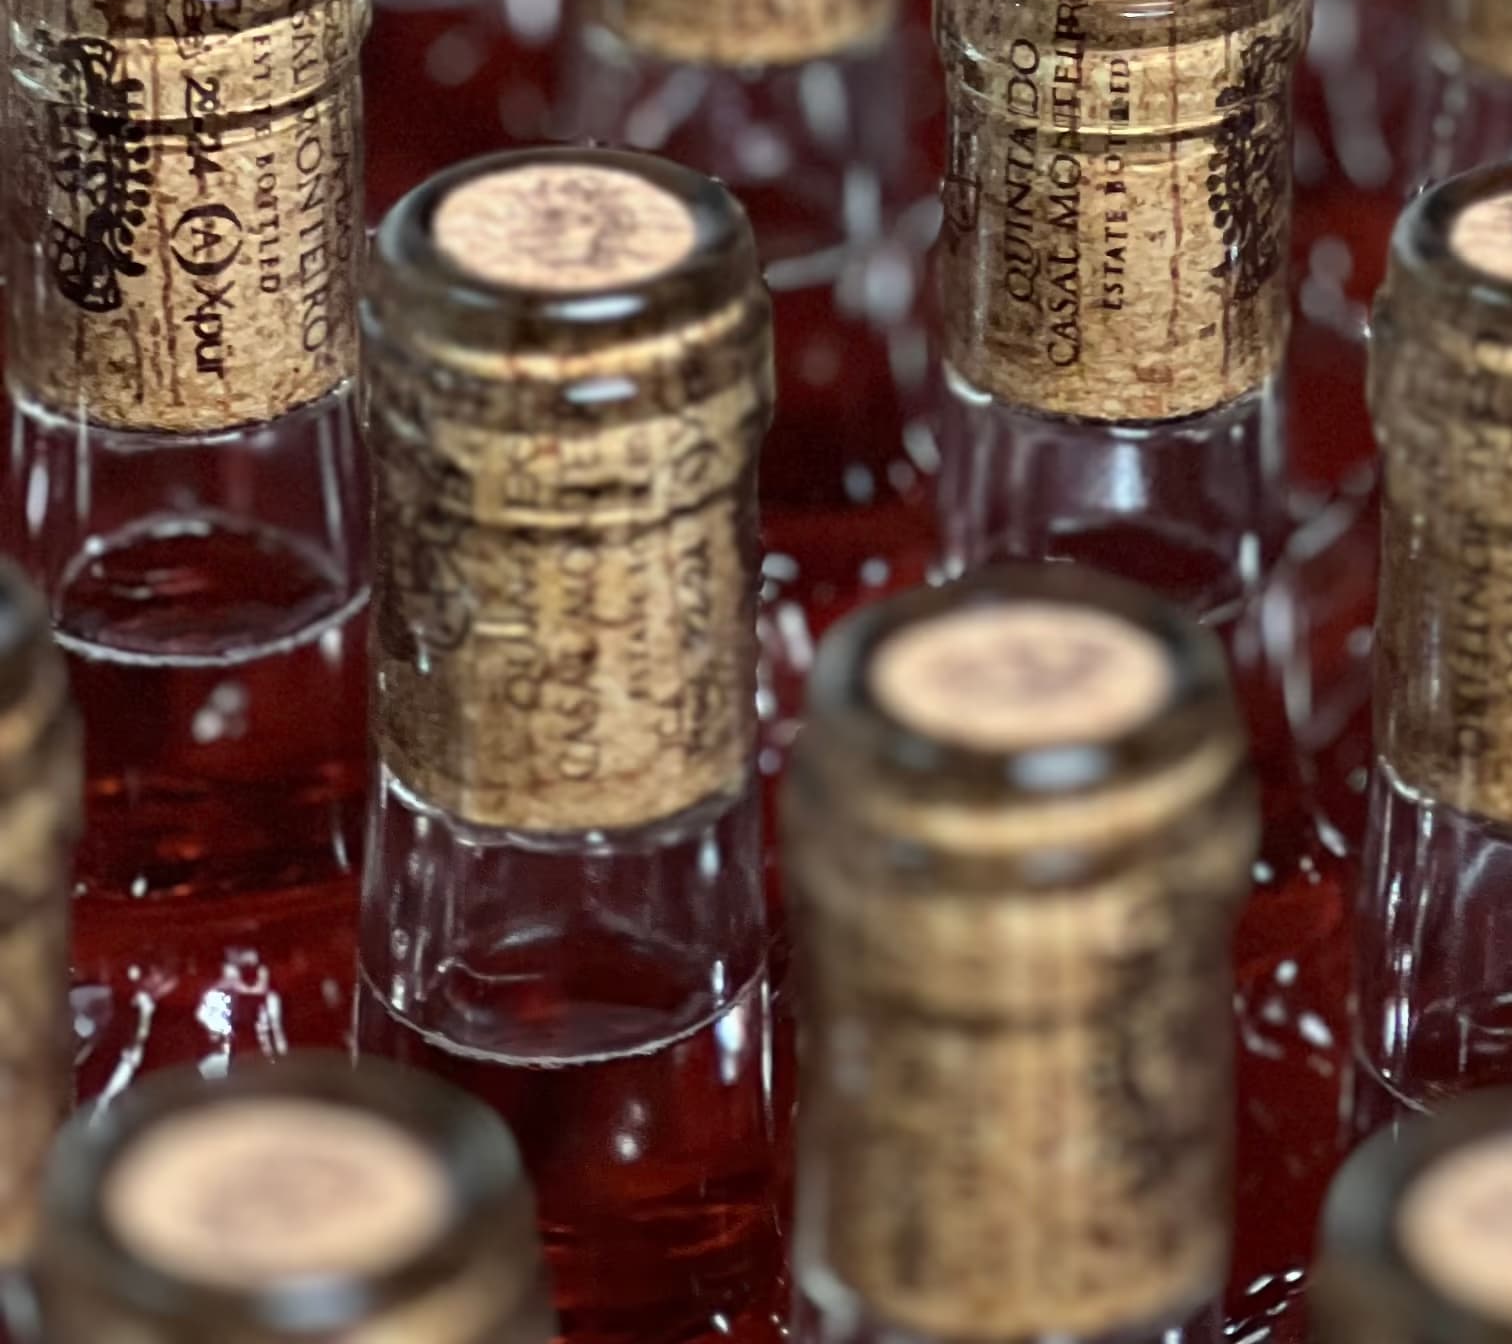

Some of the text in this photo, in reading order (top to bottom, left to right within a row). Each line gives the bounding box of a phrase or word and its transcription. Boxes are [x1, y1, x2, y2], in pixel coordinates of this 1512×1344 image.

[254, 153, 281, 294] BOTTLED
[1005, 37, 1043, 311] QUINTA DO
[1044, 248, 1081, 368] CASAL
[1101, 209, 1128, 311] ESTATE
[184, 278, 236, 380] Xpür
